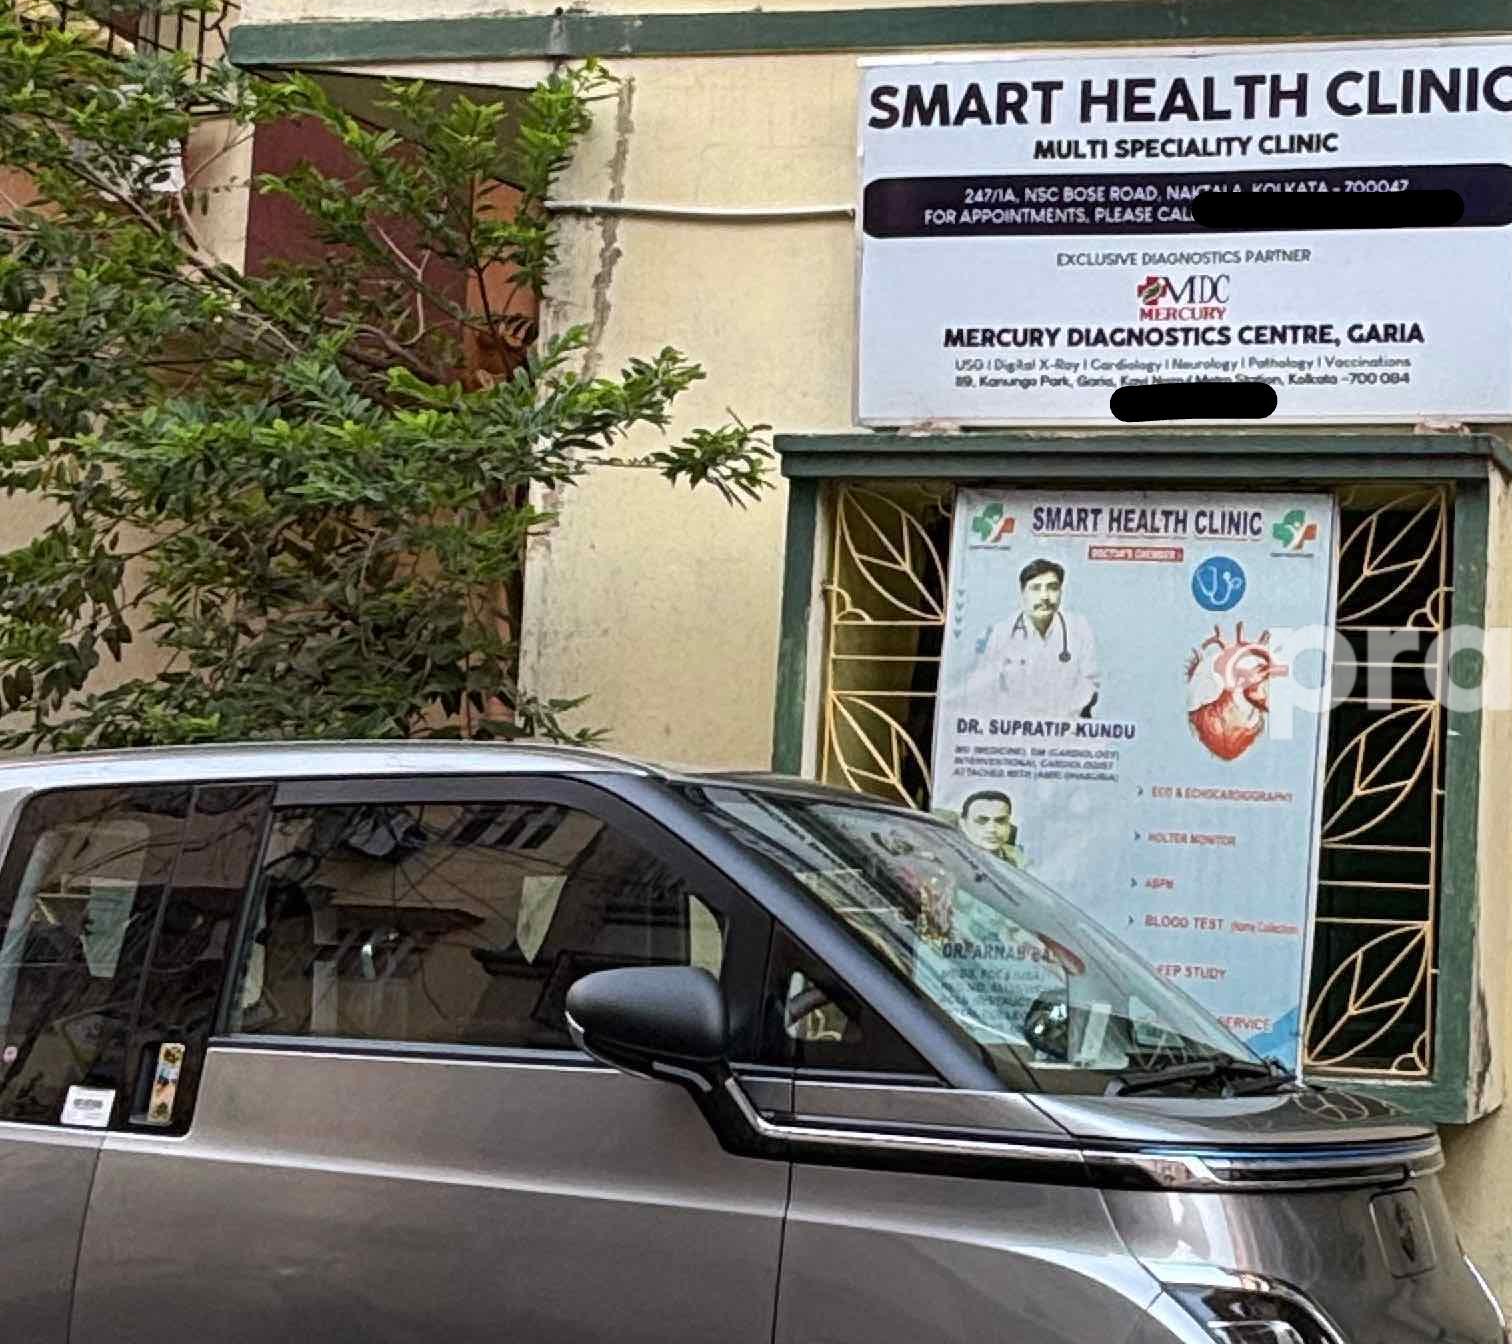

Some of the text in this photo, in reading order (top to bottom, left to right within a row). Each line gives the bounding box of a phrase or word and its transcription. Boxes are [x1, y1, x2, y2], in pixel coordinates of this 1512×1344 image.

[868, 80, 1063, 129] SMART
[1080, 73, 1308, 123] HEALTH
[1033, 133, 1338, 160] MULTI SPECIALITY CLINIC
[1024, 188, 1058, 204] NSC
[1063, 187, 1105, 203] BOSE
[924, 210, 956, 225] FOR
[1095, 207, 1153, 224] PLEASE
[1056, 248, 1312, 267] EXCLUSIVE DIAGNOSTICS PARTNER
[1158, 274, 1231, 305] MDC
[1139, 306, 1227, 322] MERCURY
[944, 322, 1425, 348] MERCURY DIAGNOSTICS CENTRE, GARIA
[1171, 356, 1239, 373] Neurology
[1249, 356, 1314, 372] Pathology
[1324, 355, 1412, 369] Vaccinations
[1288, 373, 1338, 385] Kolkata
[1032, 506, 1263, 536] SMART HEALTH CLINIC
[956, 718, 1136, 739] DR. SUPRATIP KUNDU
[1148, 832, 1237, 847] HOLTER MONITOR
[1144, 914, 1189, 929] BLOOD
[1193, 916, 1225, 930] TEST
[1185, 966, 1227, 980] STUDY
